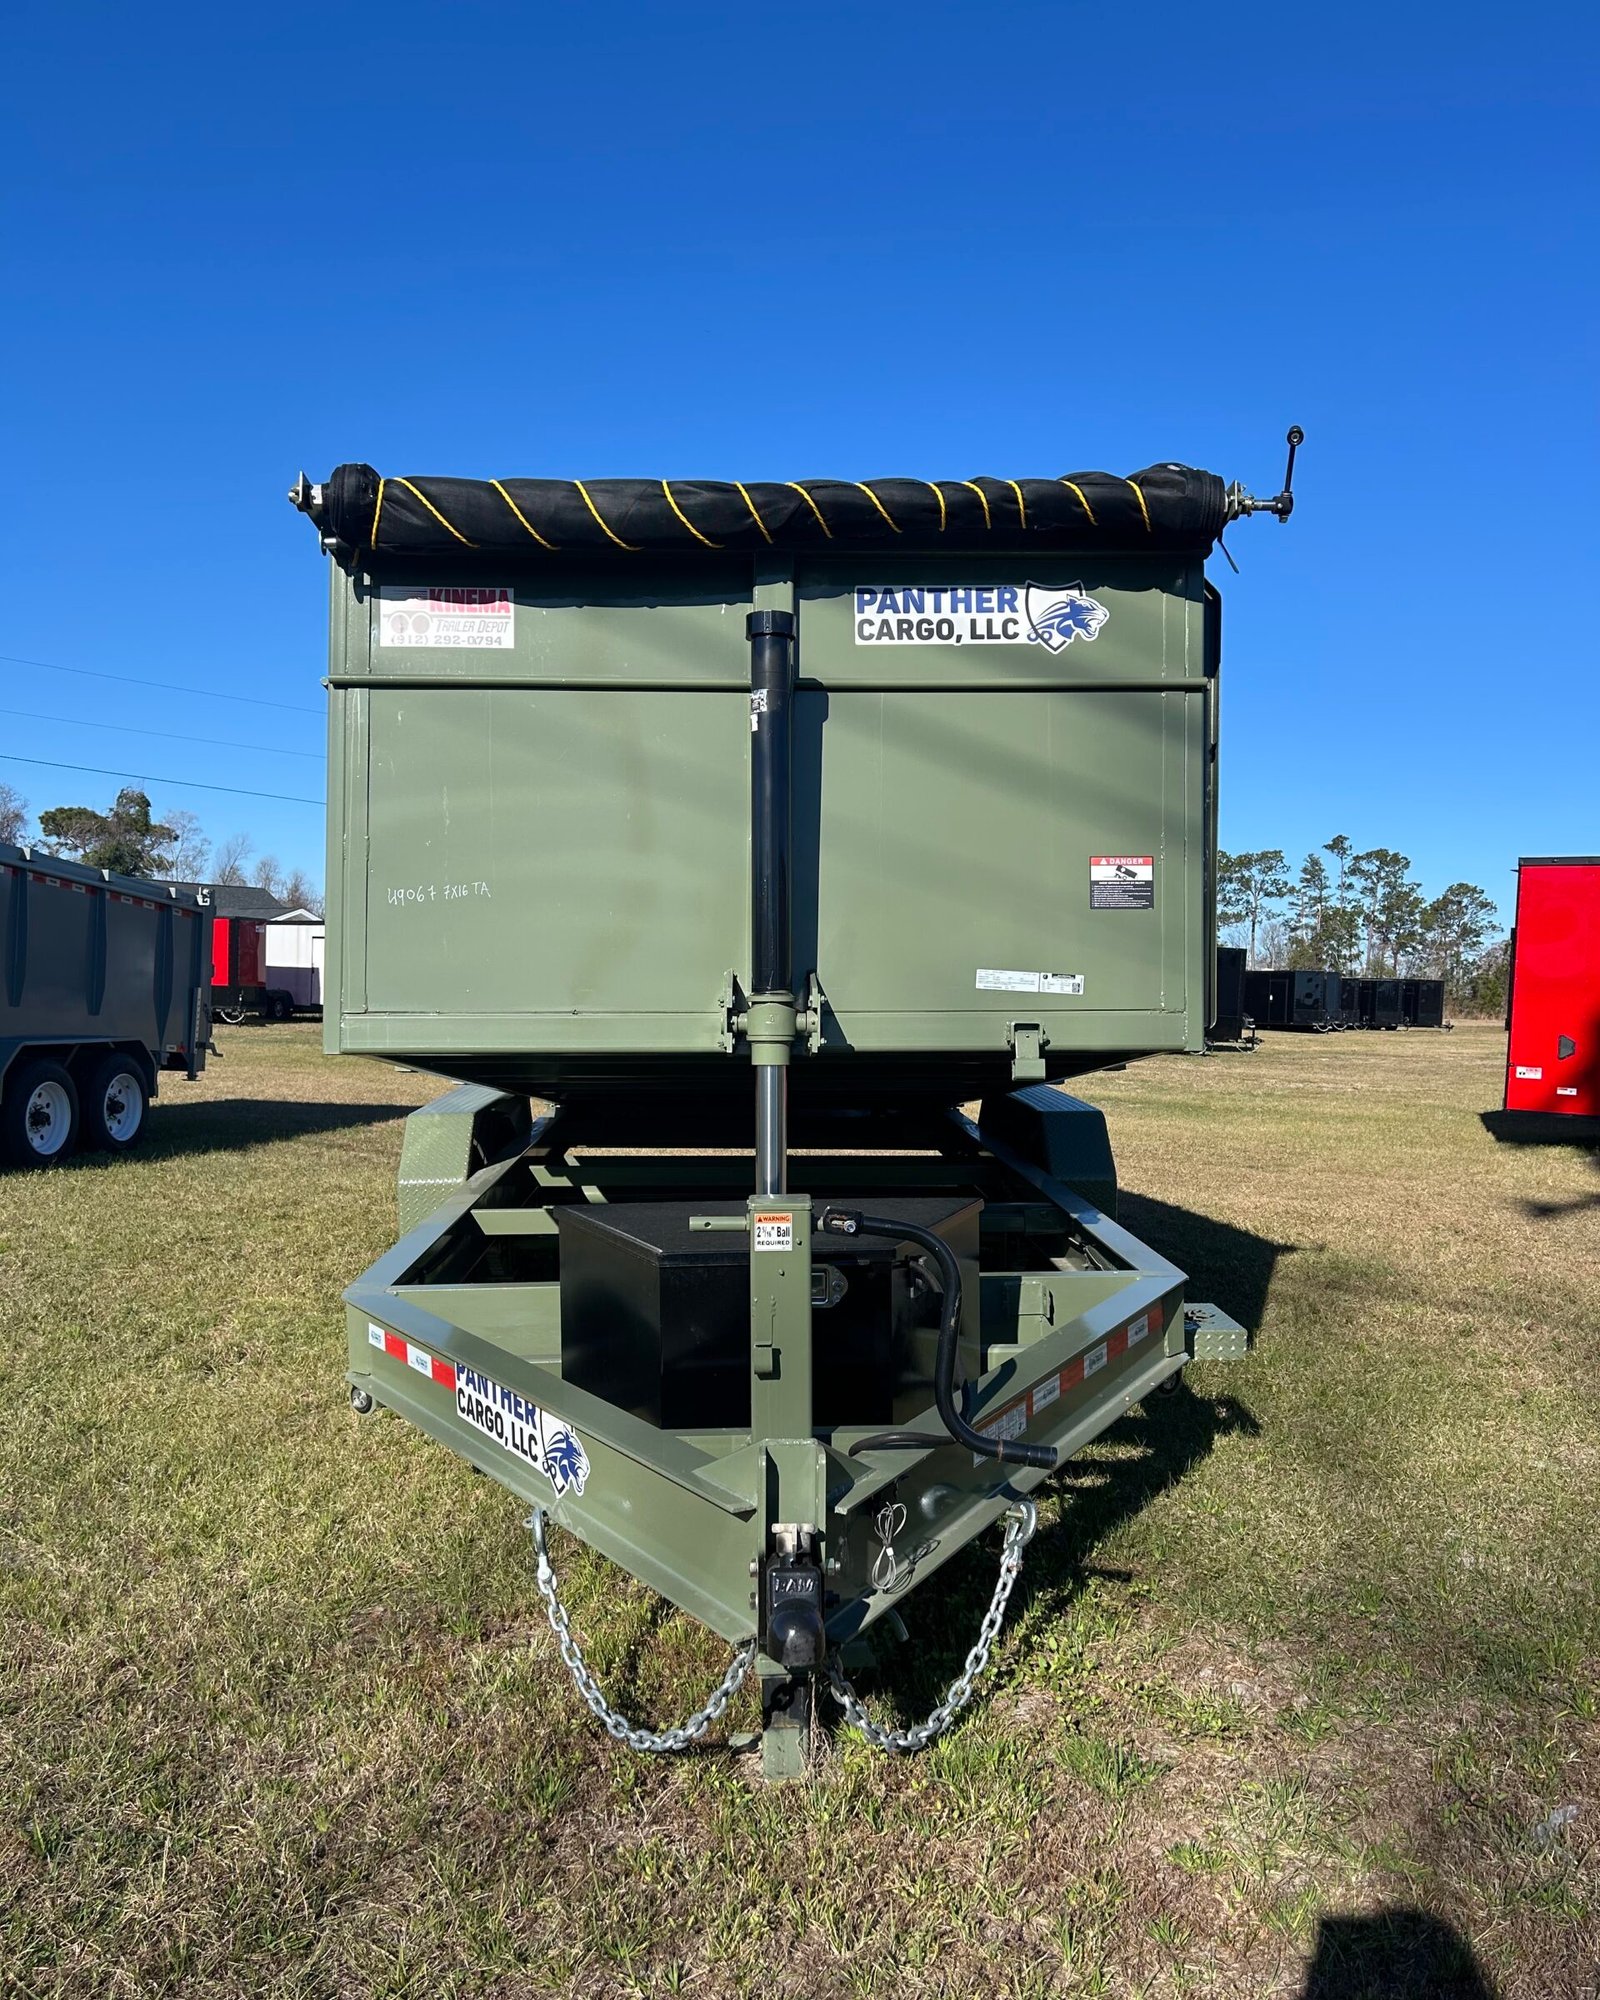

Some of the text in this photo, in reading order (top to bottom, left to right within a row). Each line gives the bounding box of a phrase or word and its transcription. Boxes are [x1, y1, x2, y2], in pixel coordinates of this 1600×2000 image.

[428, 588, 511, 614] KINEMA
[856, 587, 1019, 614] PANTHER
[436, 619, 510, 633] TRAILER DEPOT
[857, 618, 1020, 644] CARGO, LLC
[391, 635, 502, 646] (912) 292-0794
[471, 881, 491, 898] TA
[777, 1226, 790, 1237] Ball
[458, 1387, 538, 1462] CARGO, LLC
